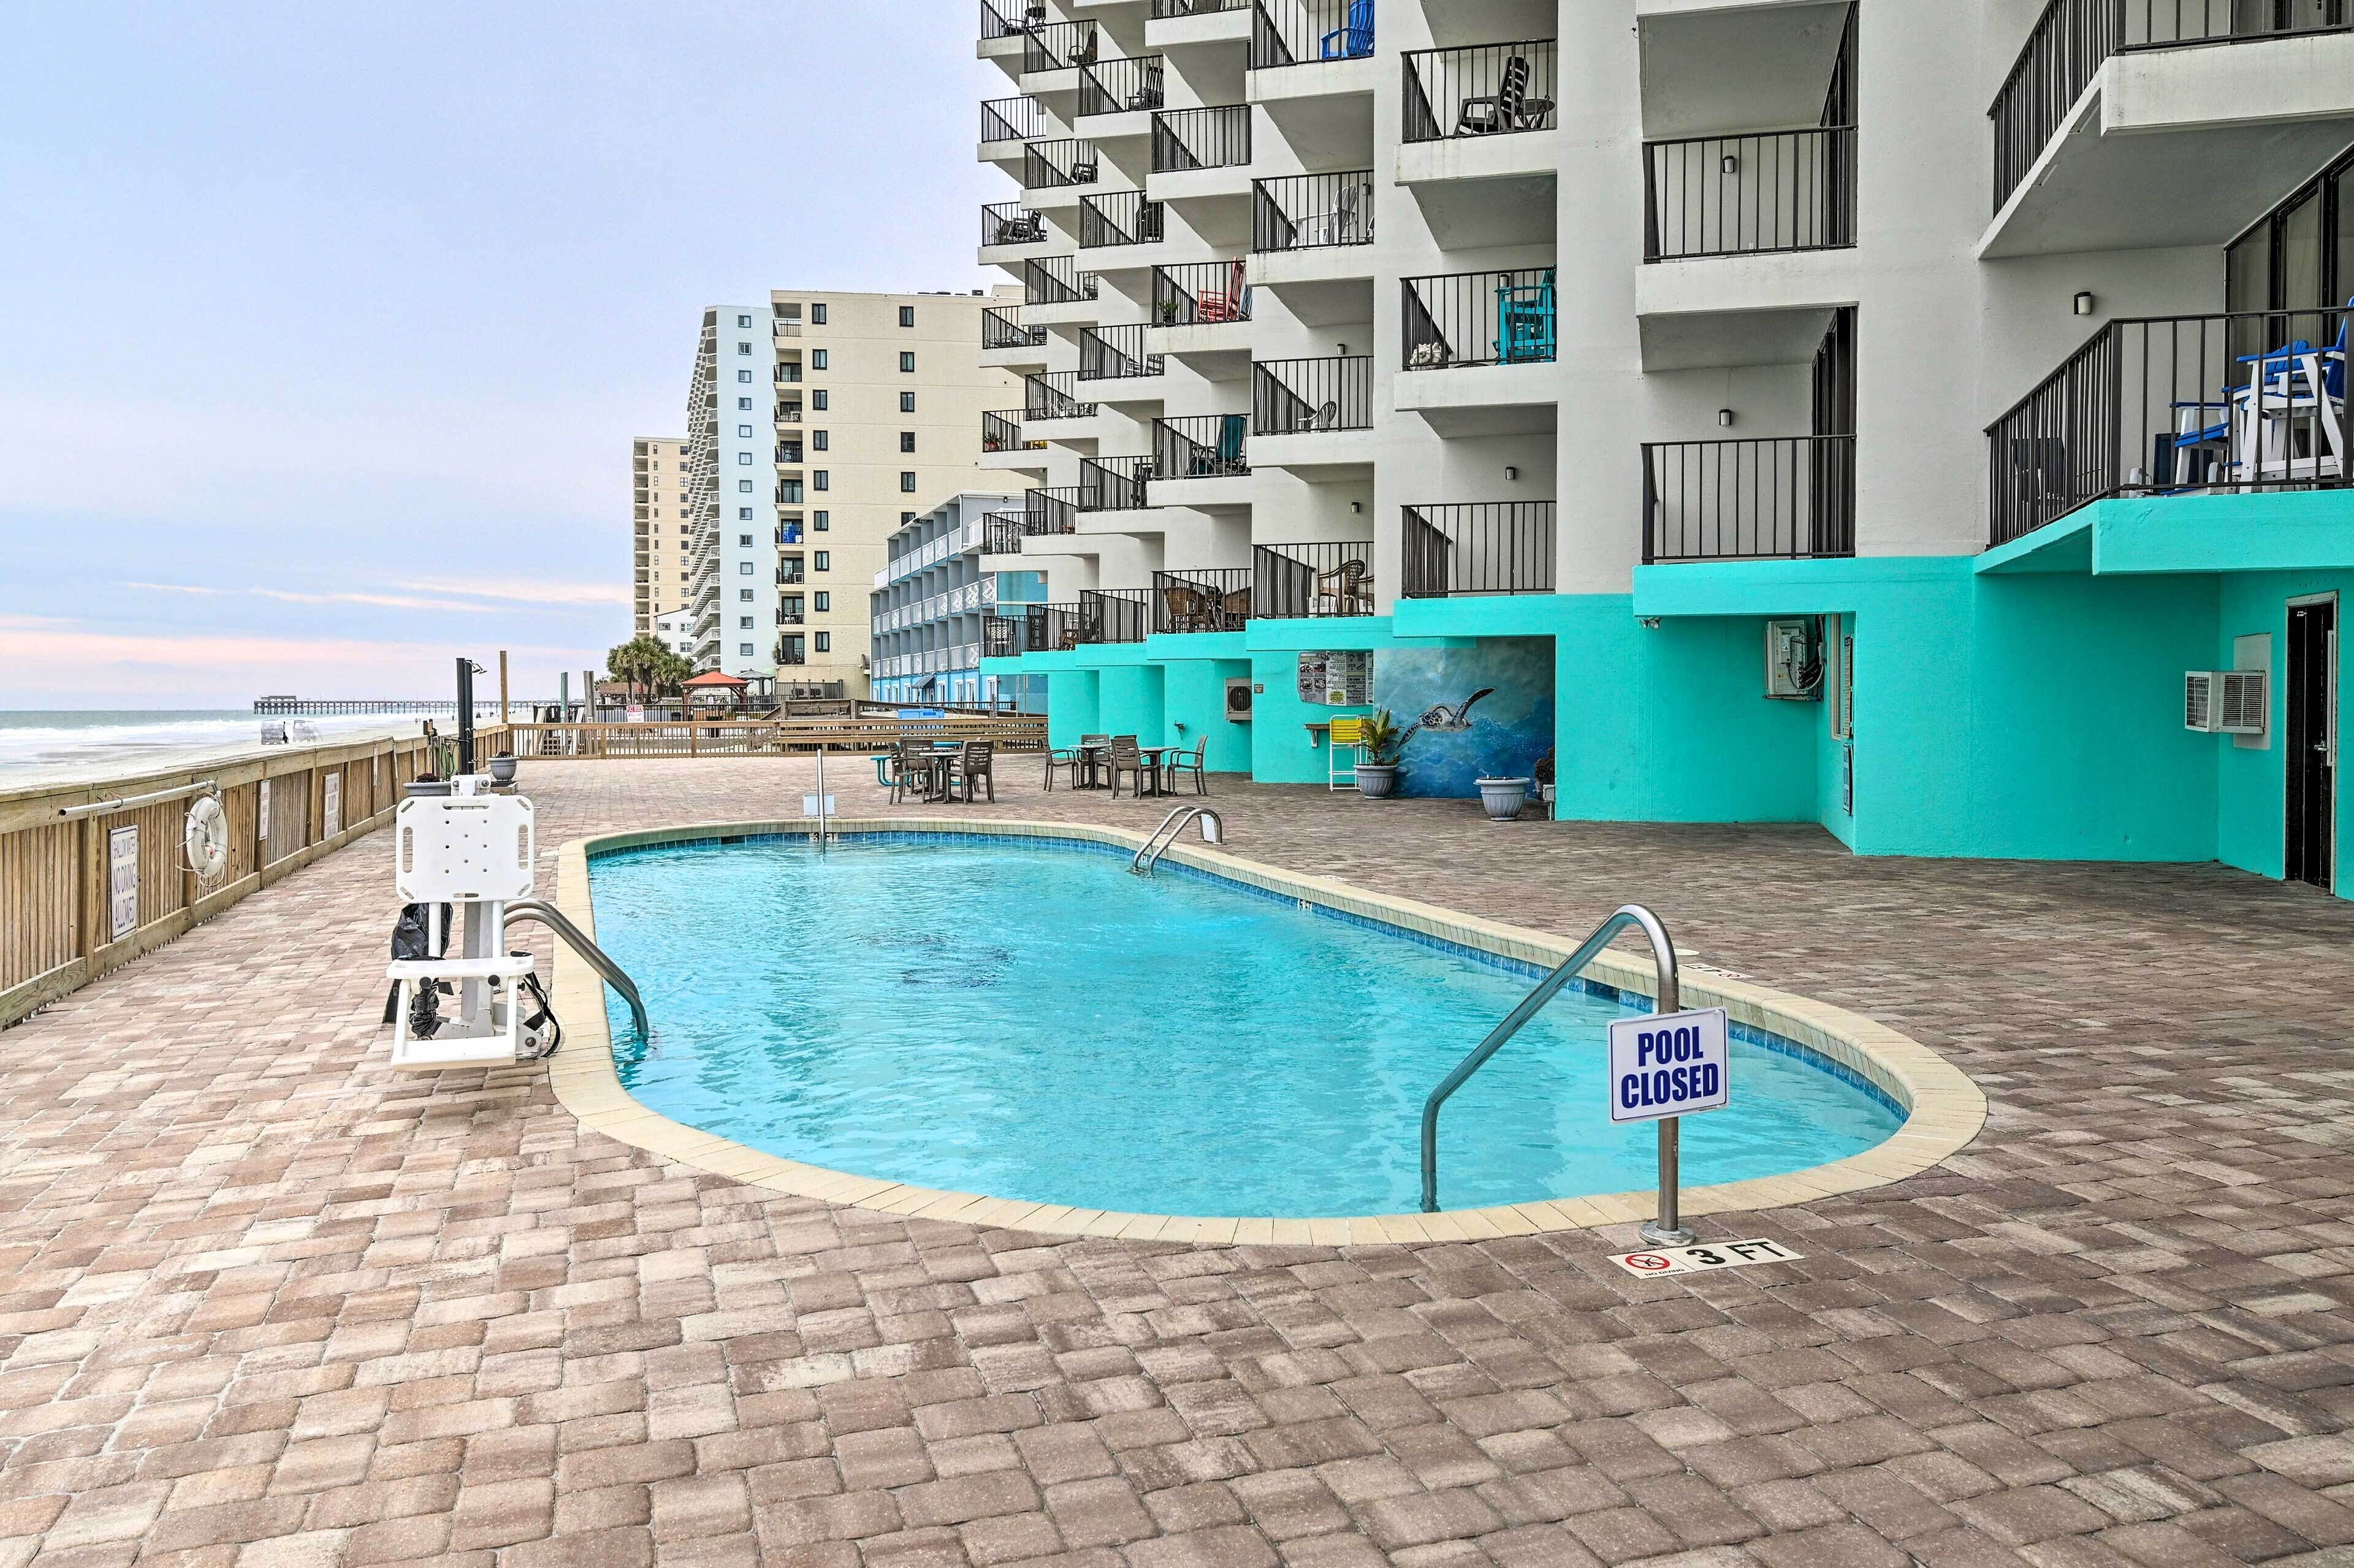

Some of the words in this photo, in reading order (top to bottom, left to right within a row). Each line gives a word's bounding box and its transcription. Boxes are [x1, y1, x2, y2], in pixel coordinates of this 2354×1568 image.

[813, 832, 820, 842] 3
[113, 866, 121, 896] NO
[121, 862, 135, 893] DIVING
[115, 895, 135, 931] ALLOWED
[1637, 1026, 1704, 1067] POOL
[1621, 1063, 1719, 1108] CLOSED
[1686, 1249, 1726, 1265] 3
[1725, 1241, 1785, 1260] FT
